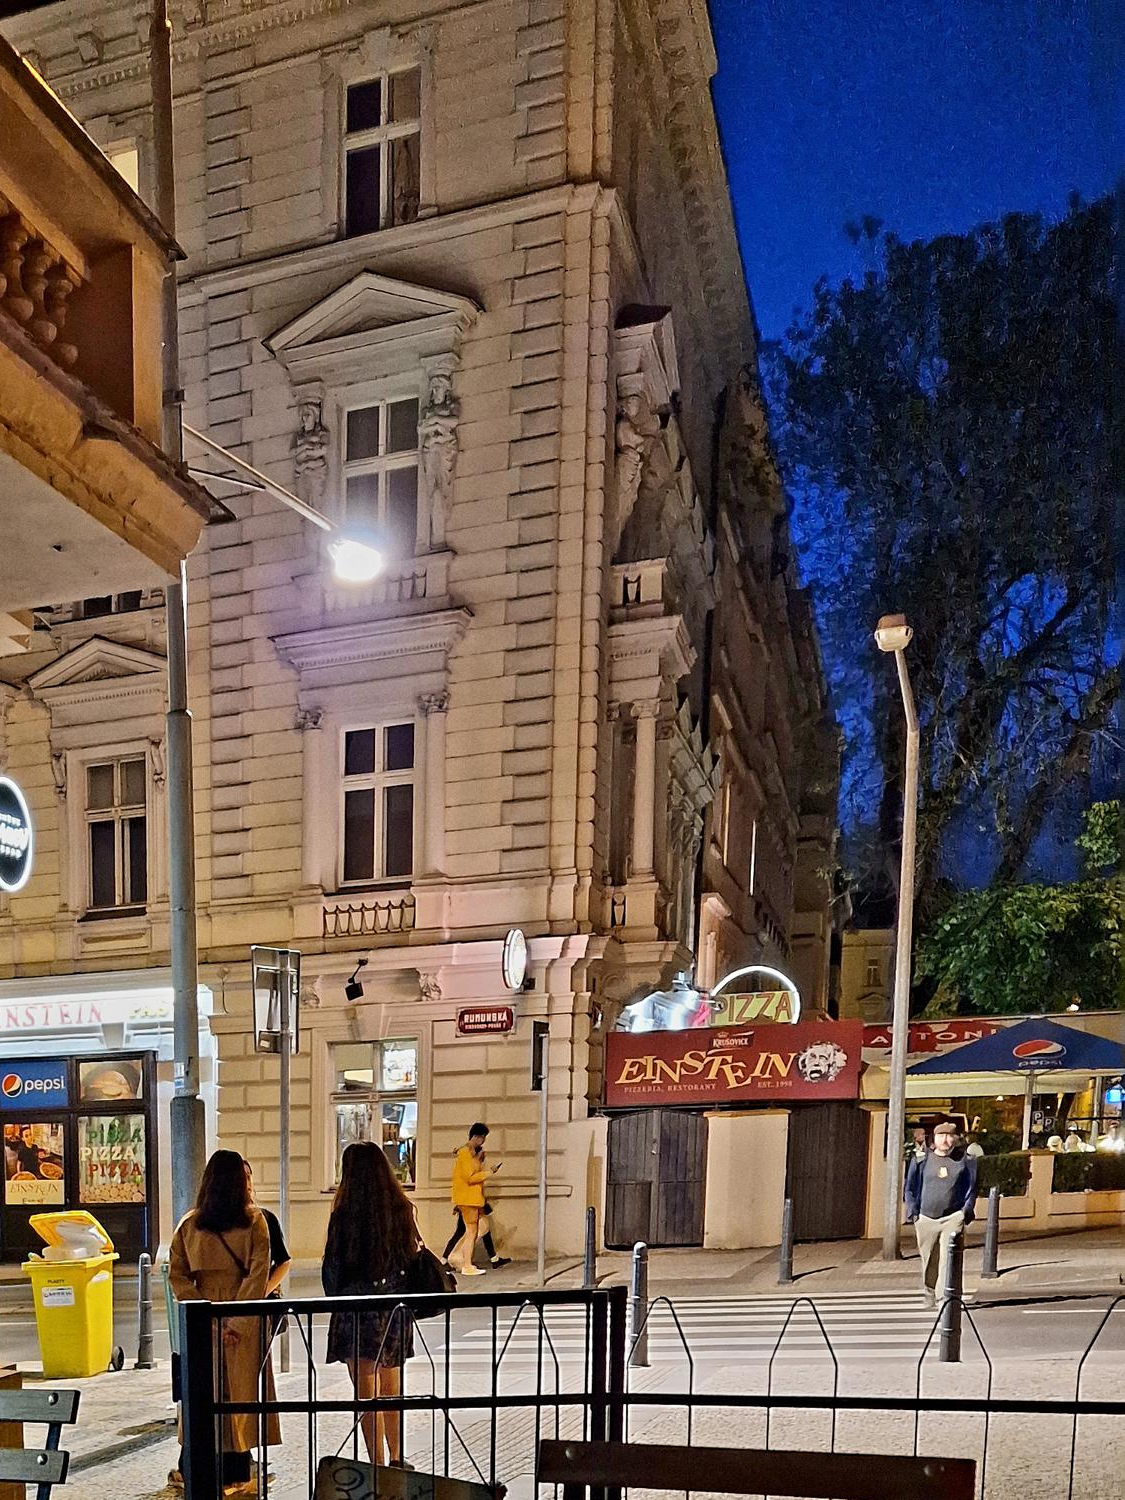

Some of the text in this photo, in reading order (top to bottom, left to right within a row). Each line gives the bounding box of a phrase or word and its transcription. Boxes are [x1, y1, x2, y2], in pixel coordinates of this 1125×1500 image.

[711, 992, 792, 1023] PIZZA
[862, 1028, 997, 1044] ATONI
[615, 1050, 797, 1089] EINSTEIN
[24, 1074, 65, 1094] pepsi
[80, 1146, 136, 1161] PIZZA
